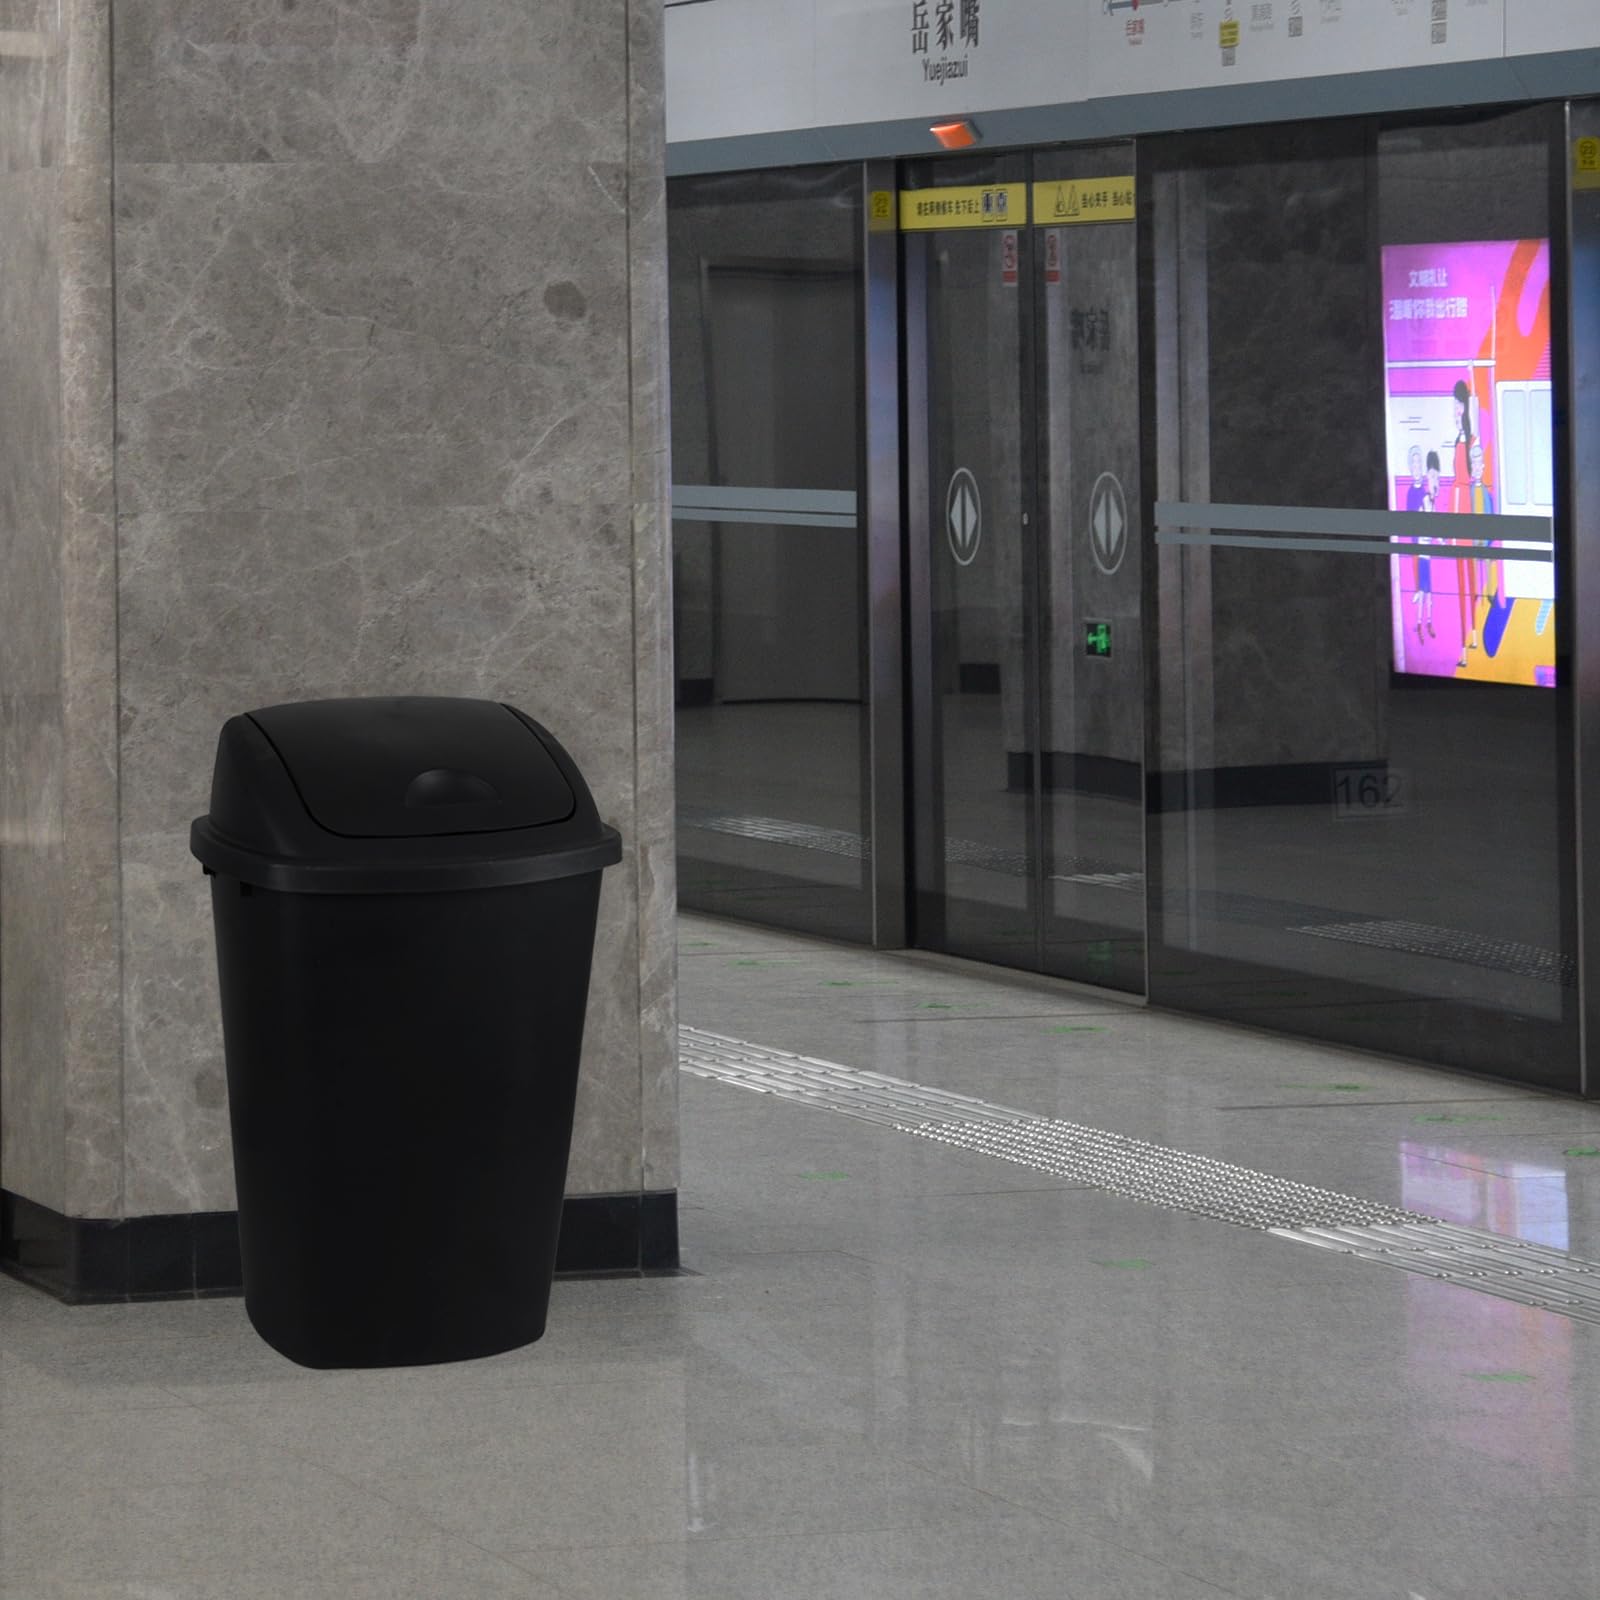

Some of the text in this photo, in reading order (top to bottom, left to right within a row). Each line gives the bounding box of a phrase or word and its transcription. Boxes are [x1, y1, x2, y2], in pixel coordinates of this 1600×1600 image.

[911, 0, 980, 54] 岳家嘴
[921, 53, 969, 87] Yuejiazui
[1337, 773, 1404, 808] 162
